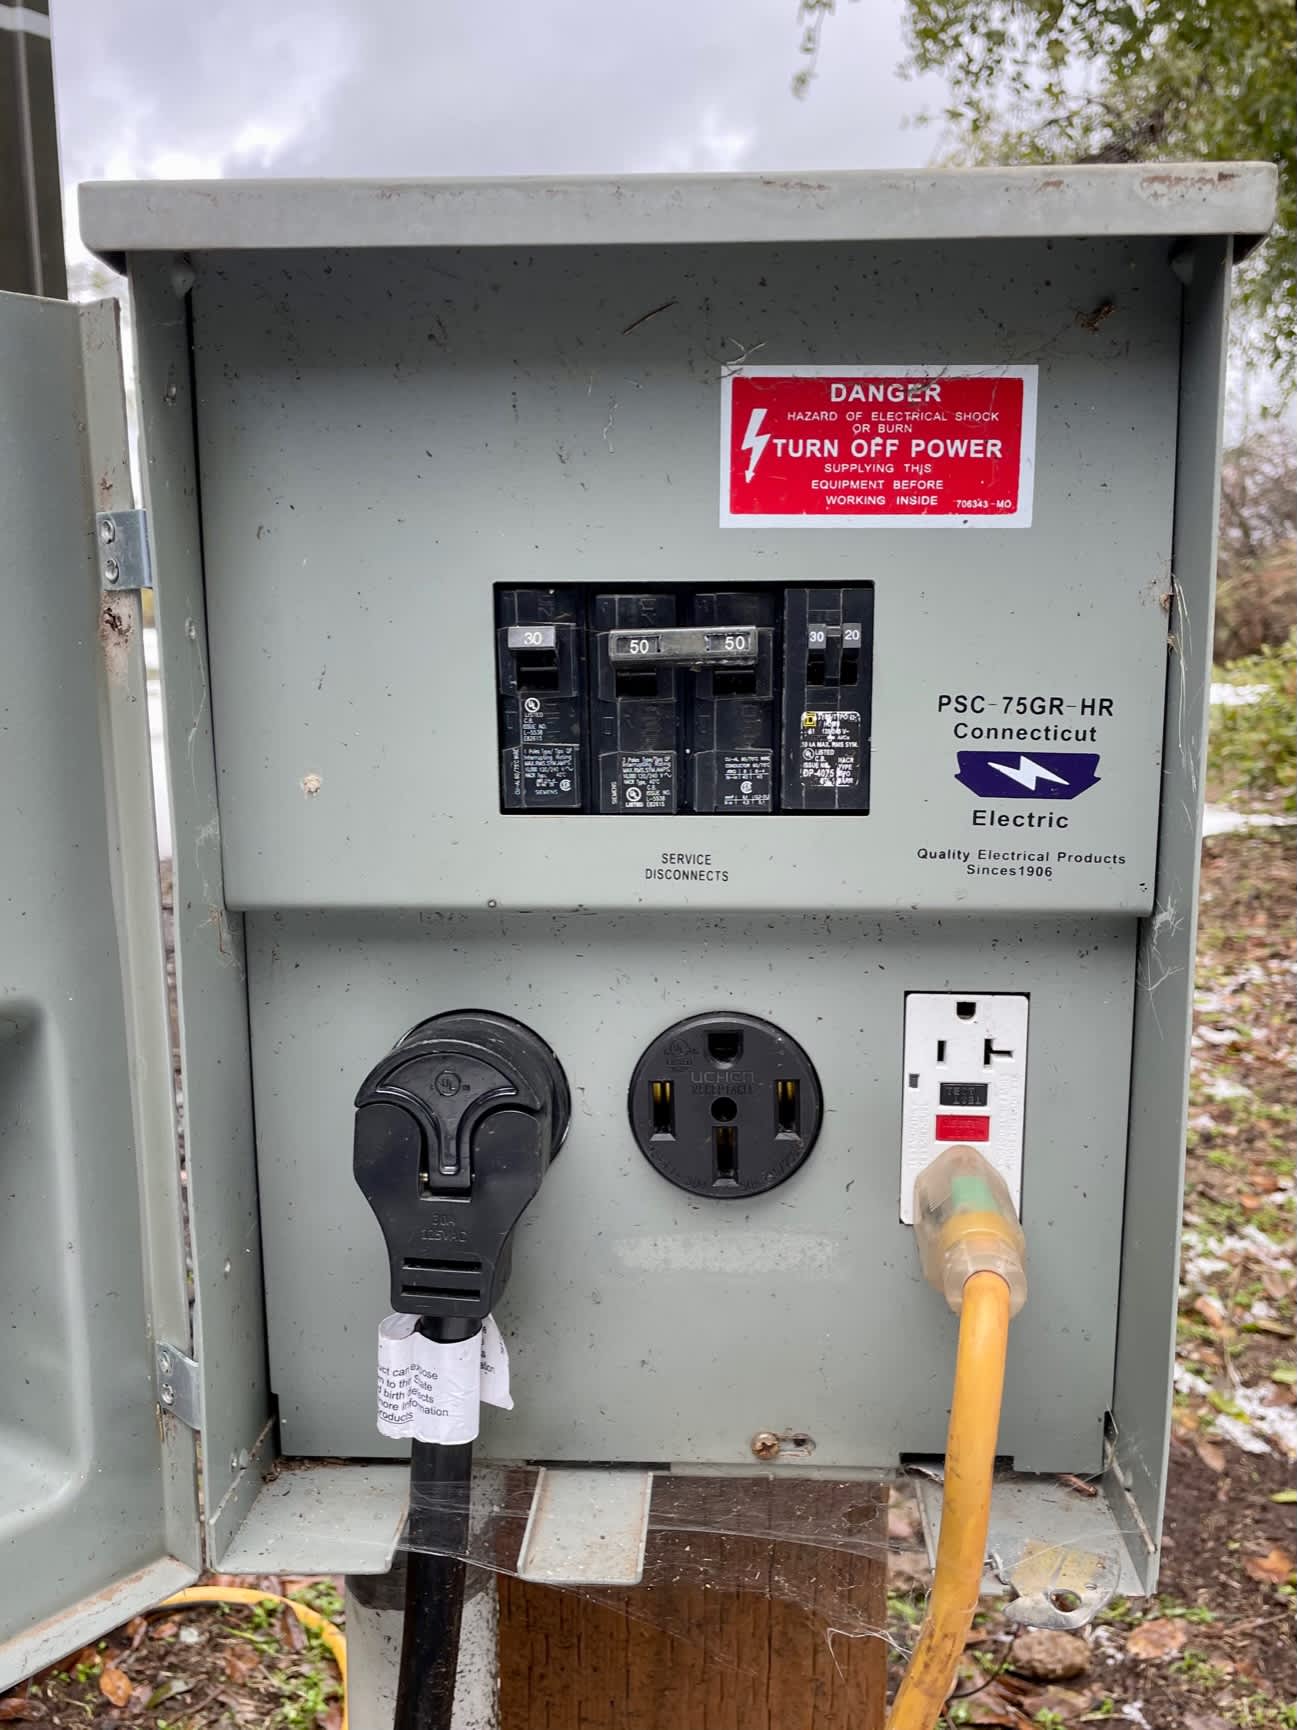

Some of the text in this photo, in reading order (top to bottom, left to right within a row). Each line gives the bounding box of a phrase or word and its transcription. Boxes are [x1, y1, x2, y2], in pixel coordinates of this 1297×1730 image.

[830, 383, 941, 403] DANGER
[787, 411, 999, 422] HAZARD OF ELECTRICAL SHOCK
[853, 424, 913, 434] OR BURN
[773, 439, 1002, 458] TURN OFF POWER
[824, 463, 932, 474] SUPPLYING THIS
[811, 480, 943, 490] EQUIPMENT BEFORE
[826, 496, 938, 506] WORKING INSIDE
[524, 632, 542, 645] 30
[809, 631, 825, 642] 30
[844, 630, 859, 640] 20
[630, 639, 649, 654] 50
[725, 637, 745, 649] 50
[938, 695, 1114, 716] PSC-75GR-HR
[953, 722, 1097, 742] Connecticut
[972, 810, 1069, 829] Electric
[661, 853, 712, 865] SERVICE
[917, 848, 1126, 864] Quality Electrical Products
[645, 868, 729, 882] DISCONNECTS
[967, 865, 1052, 877] Sinces1906
[393, 1367, 409, 1377] can
[386, 1380, 396, 1388] to
[384, 1389, 405, 1400] birth
